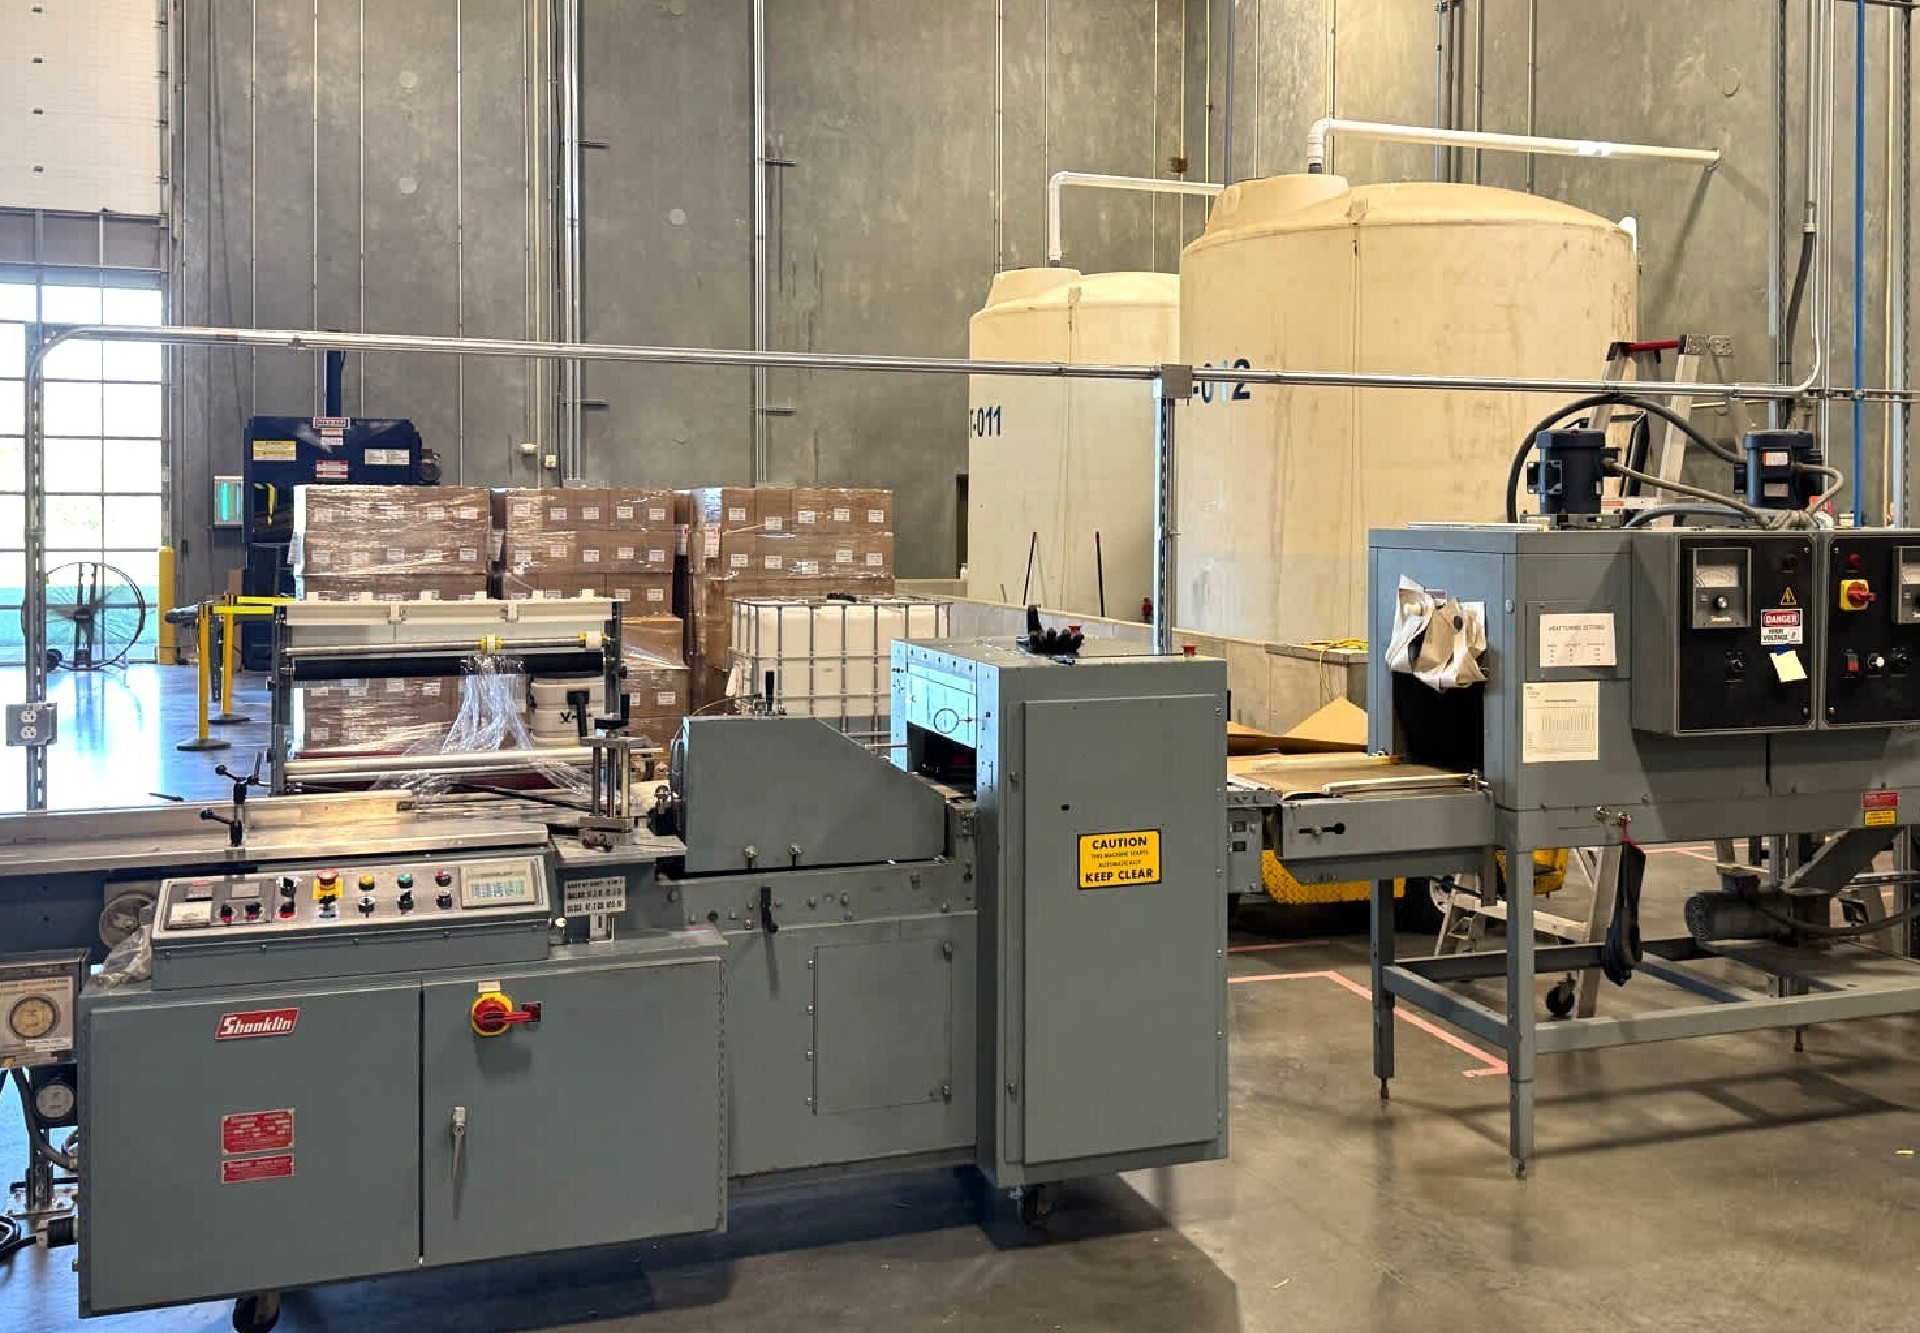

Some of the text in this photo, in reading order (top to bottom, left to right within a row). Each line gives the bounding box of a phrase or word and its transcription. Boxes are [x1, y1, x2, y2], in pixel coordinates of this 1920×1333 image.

[1765, 615, 1797, 623] DANGER
[1092, 836, 1147, 849] CAUTION
[1085, 868, 1154, 883] KEEP CLEAR
